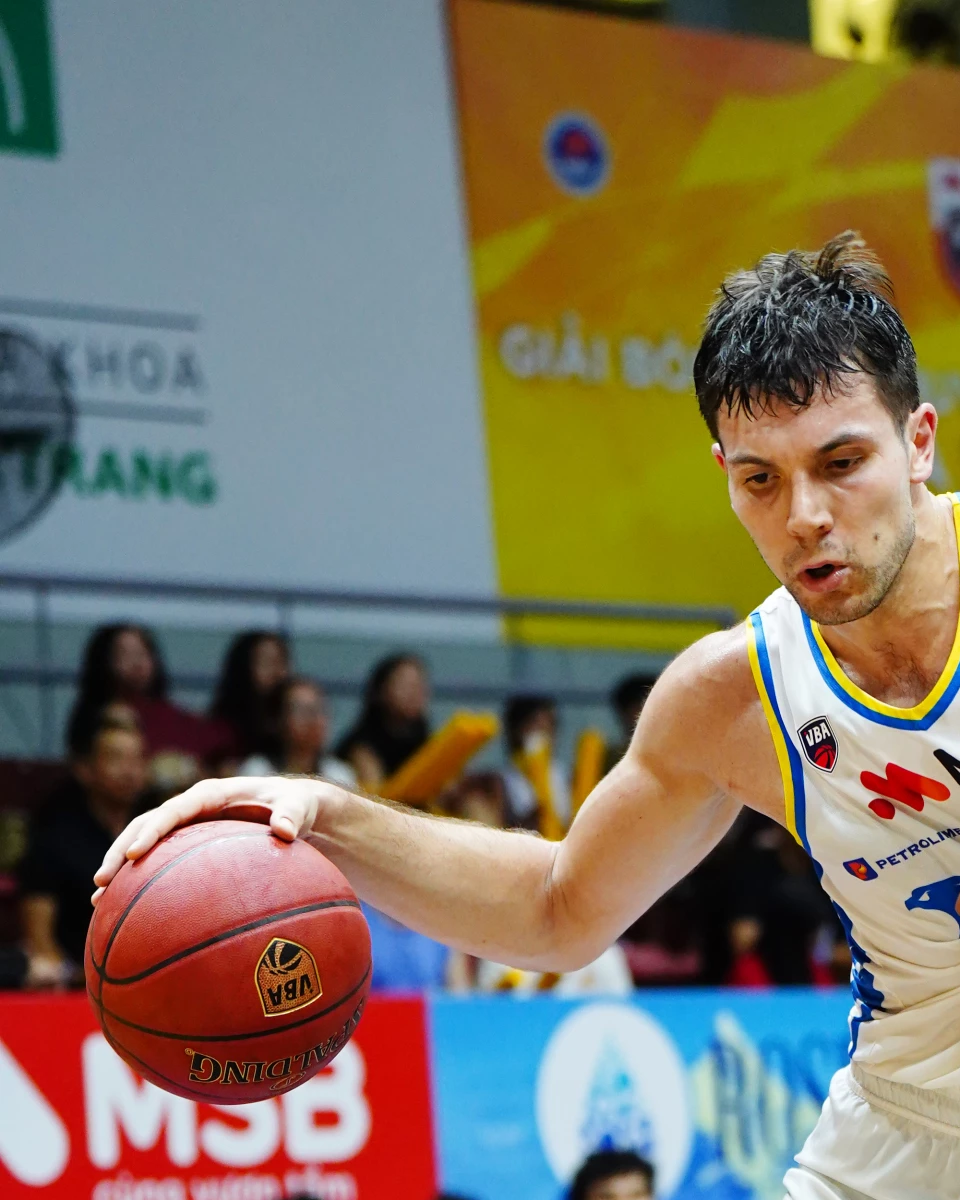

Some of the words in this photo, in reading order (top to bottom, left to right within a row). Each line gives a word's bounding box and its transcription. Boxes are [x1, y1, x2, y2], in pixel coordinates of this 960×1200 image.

[804, 722, 831, 748] VBA
[267, 974, 312, 1007] VBA
[81, 1030, 372, 1171] MSB
